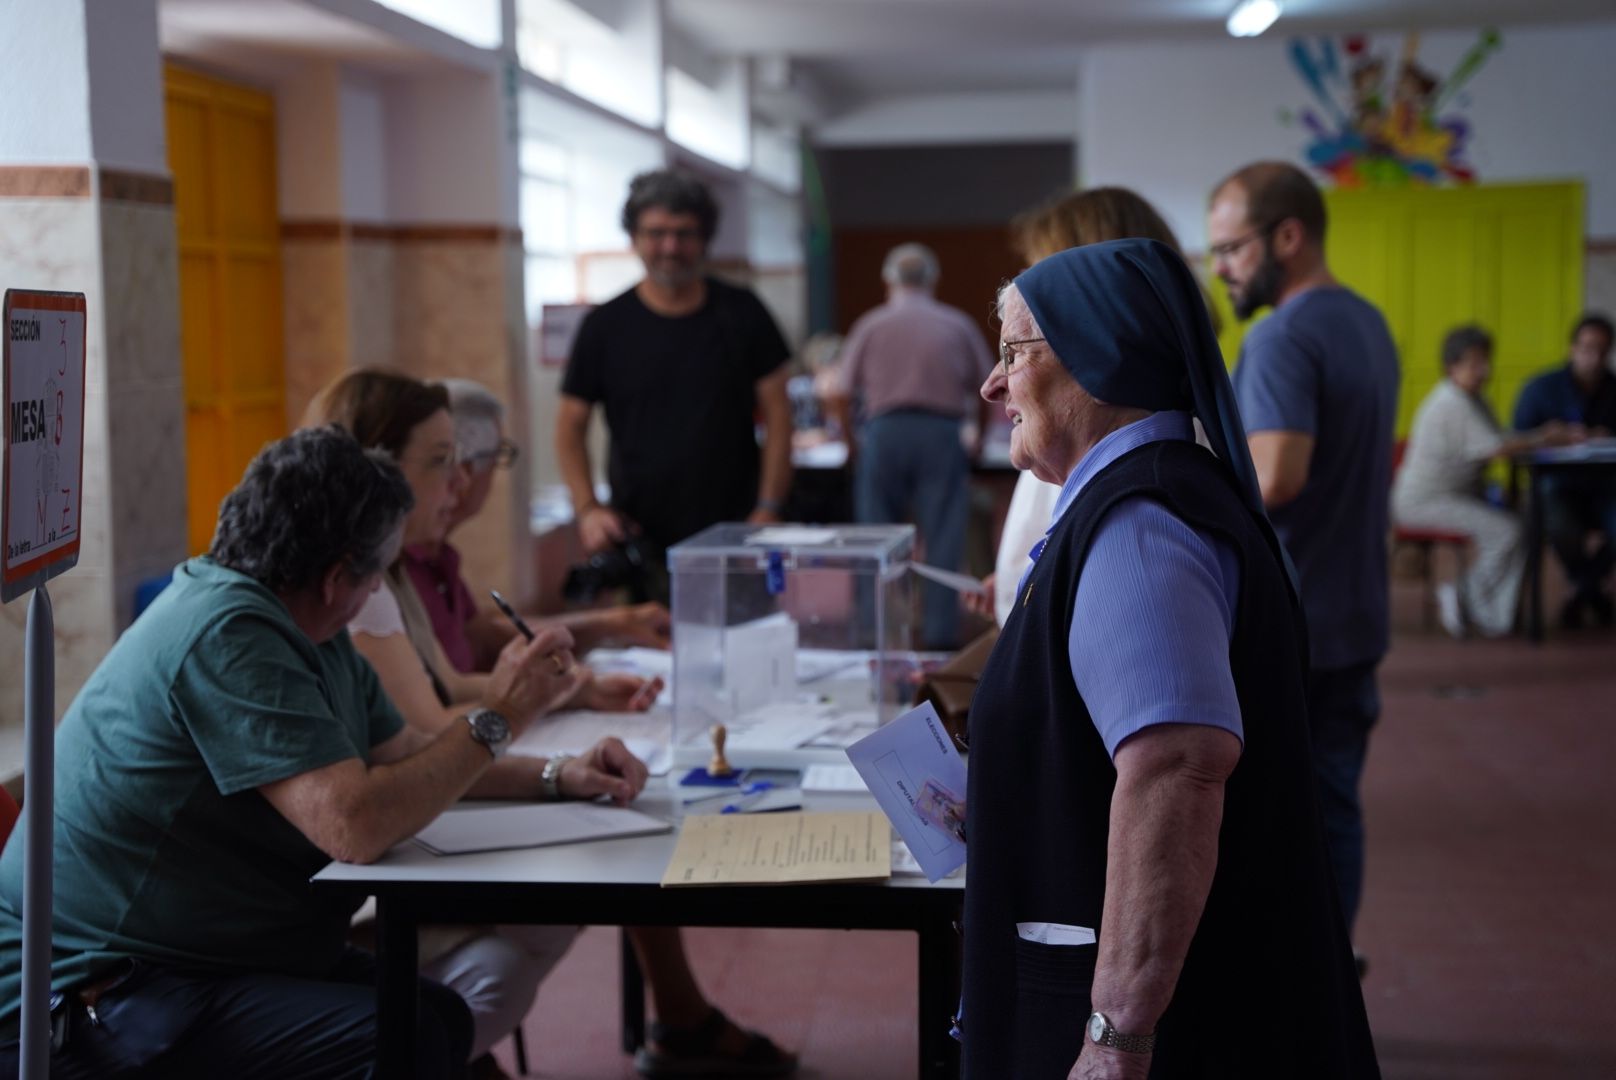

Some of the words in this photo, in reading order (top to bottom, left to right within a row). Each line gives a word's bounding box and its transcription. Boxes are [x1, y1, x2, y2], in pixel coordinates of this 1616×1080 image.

[10, 315, 41, 341] SECCIÓN
[11, 399, 46, 445] MESA
[8, 544, 14, 559] De
[925, 716, 948, 754] ELECCIONES
